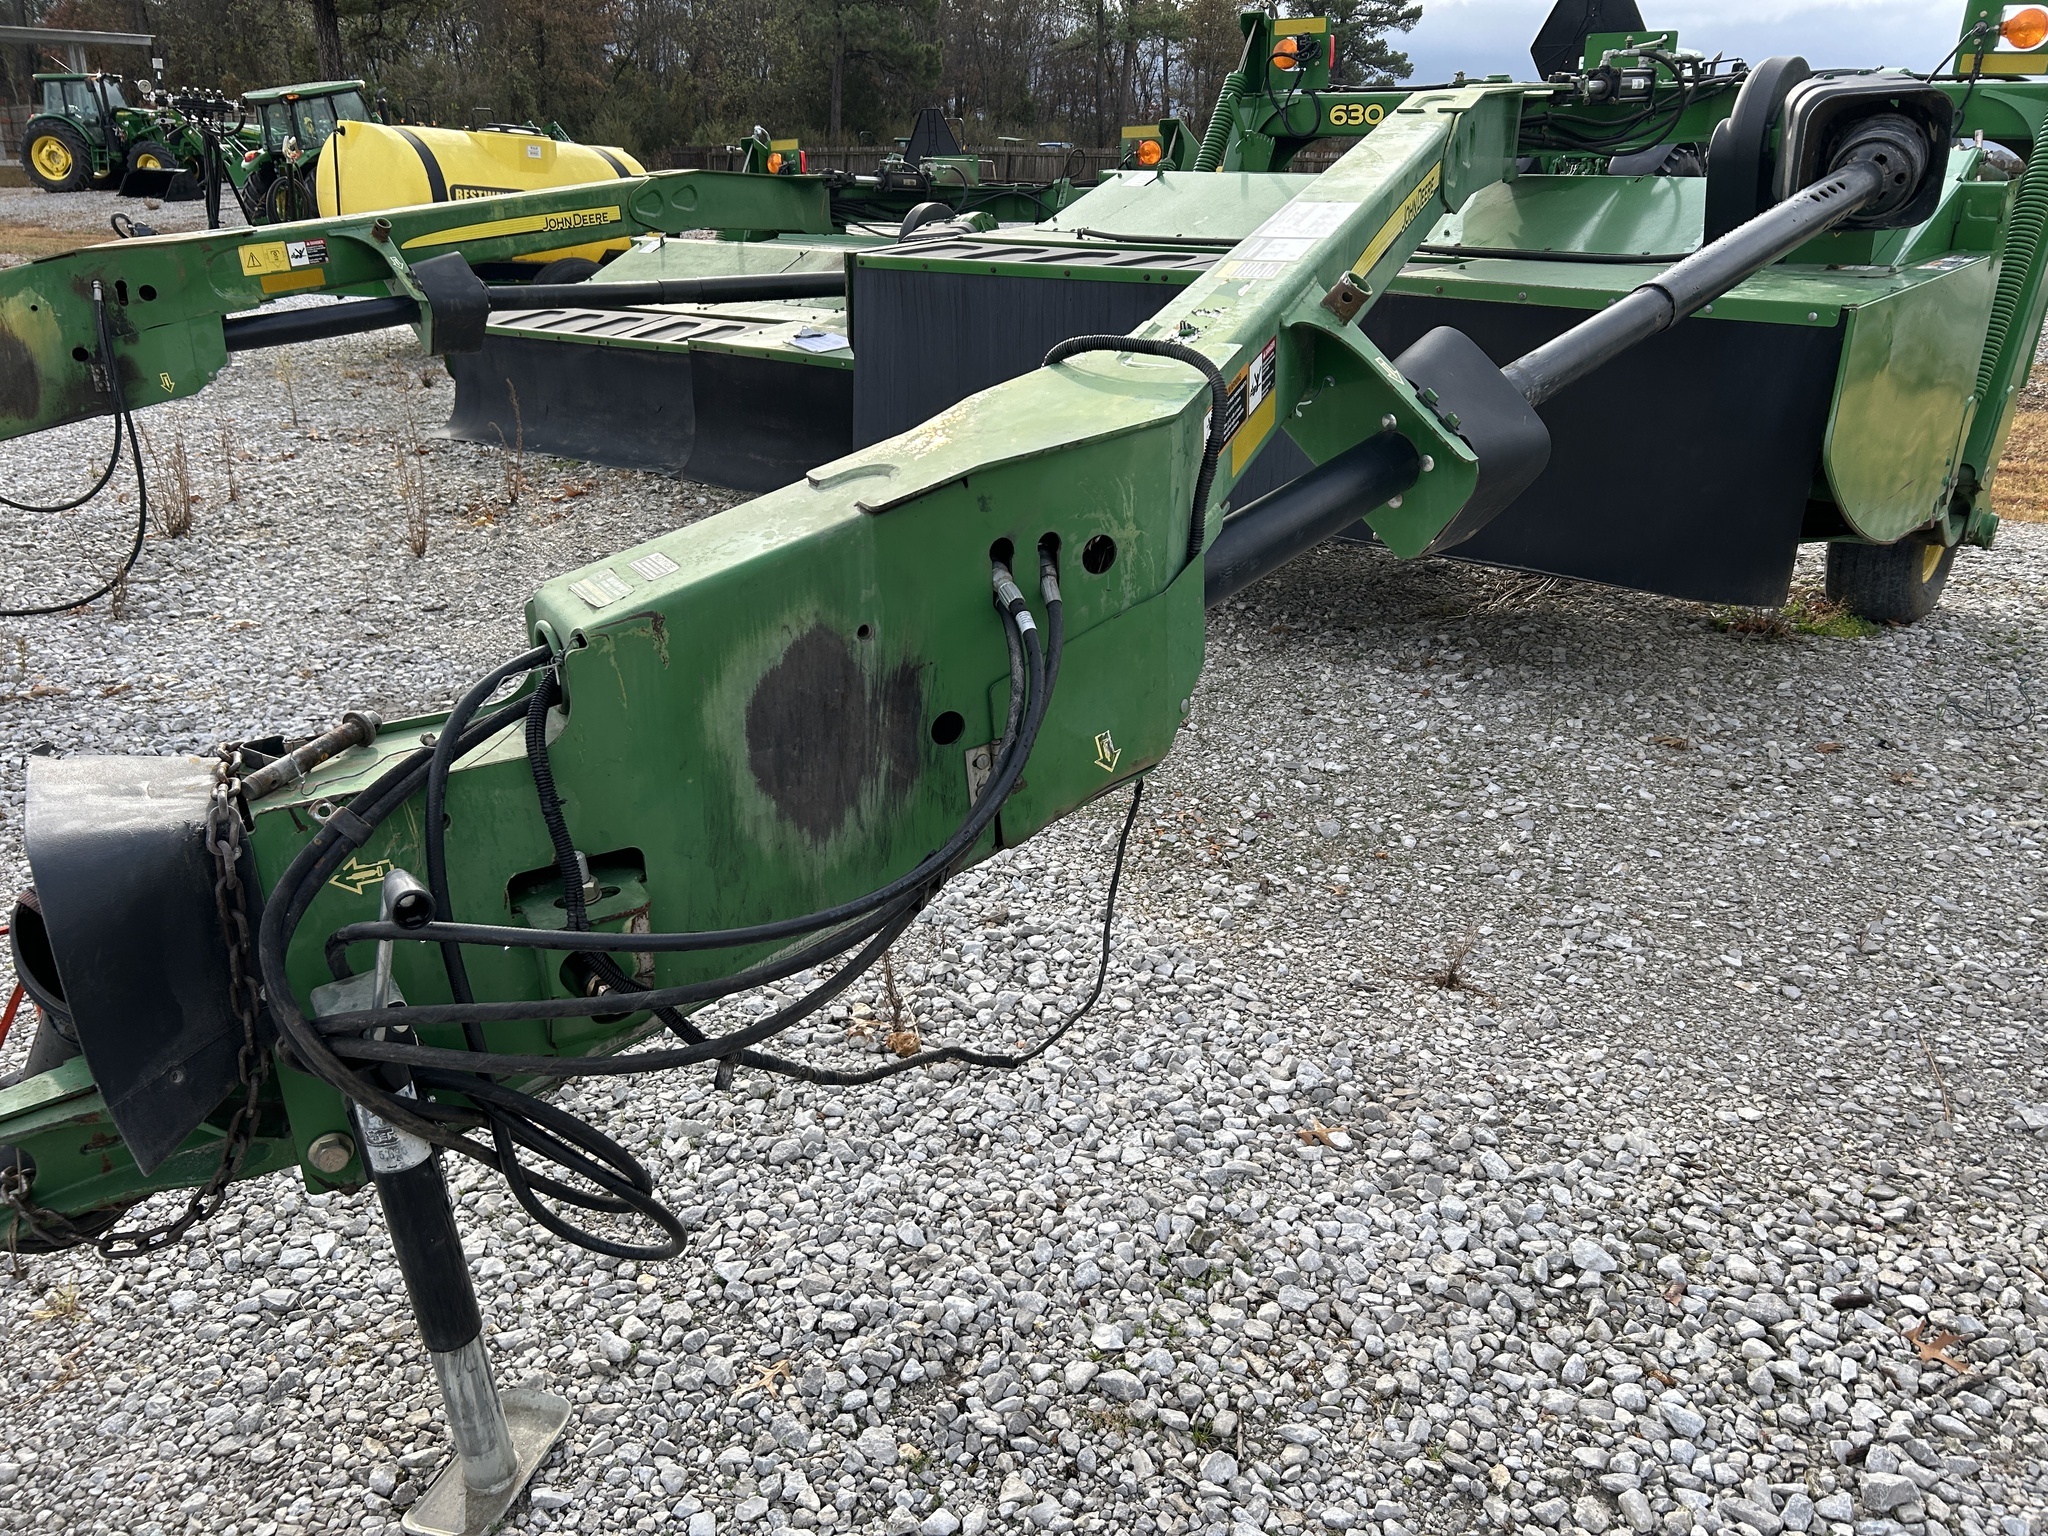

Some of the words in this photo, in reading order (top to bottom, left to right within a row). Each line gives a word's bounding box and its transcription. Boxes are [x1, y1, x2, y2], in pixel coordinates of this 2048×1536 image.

[1329, 103, 1385, 126] 630
[455, 188, 507, 201] BEST
[542, 216, 573, 232] JOHN
[573, 212, 609, 227] DEERE
